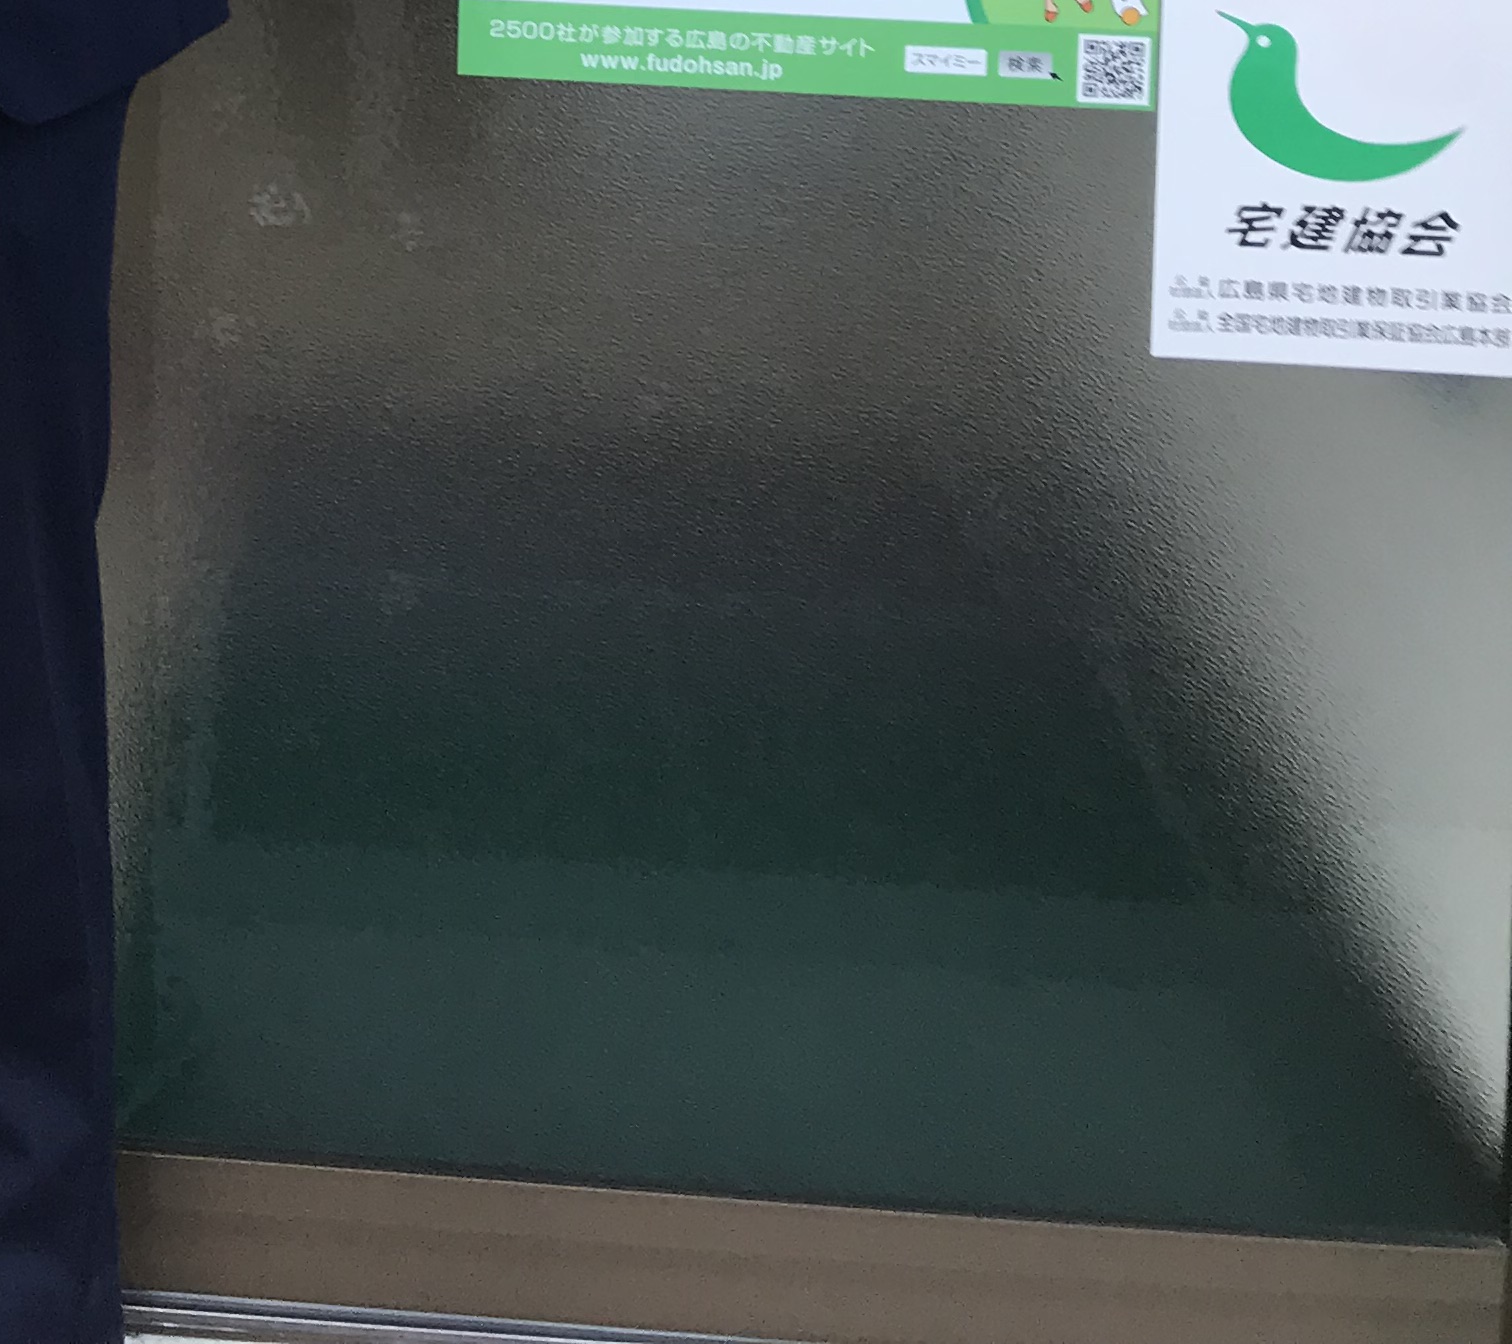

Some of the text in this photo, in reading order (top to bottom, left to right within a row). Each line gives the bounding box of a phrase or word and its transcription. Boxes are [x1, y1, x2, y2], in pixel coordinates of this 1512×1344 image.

[489, 18, 876, 56] 2500社が参加する広島の不動産サイト
[580, 51, 784, 80] www.fudohsan.jp
[1226, 200, 1463, 258] 宅建協会
